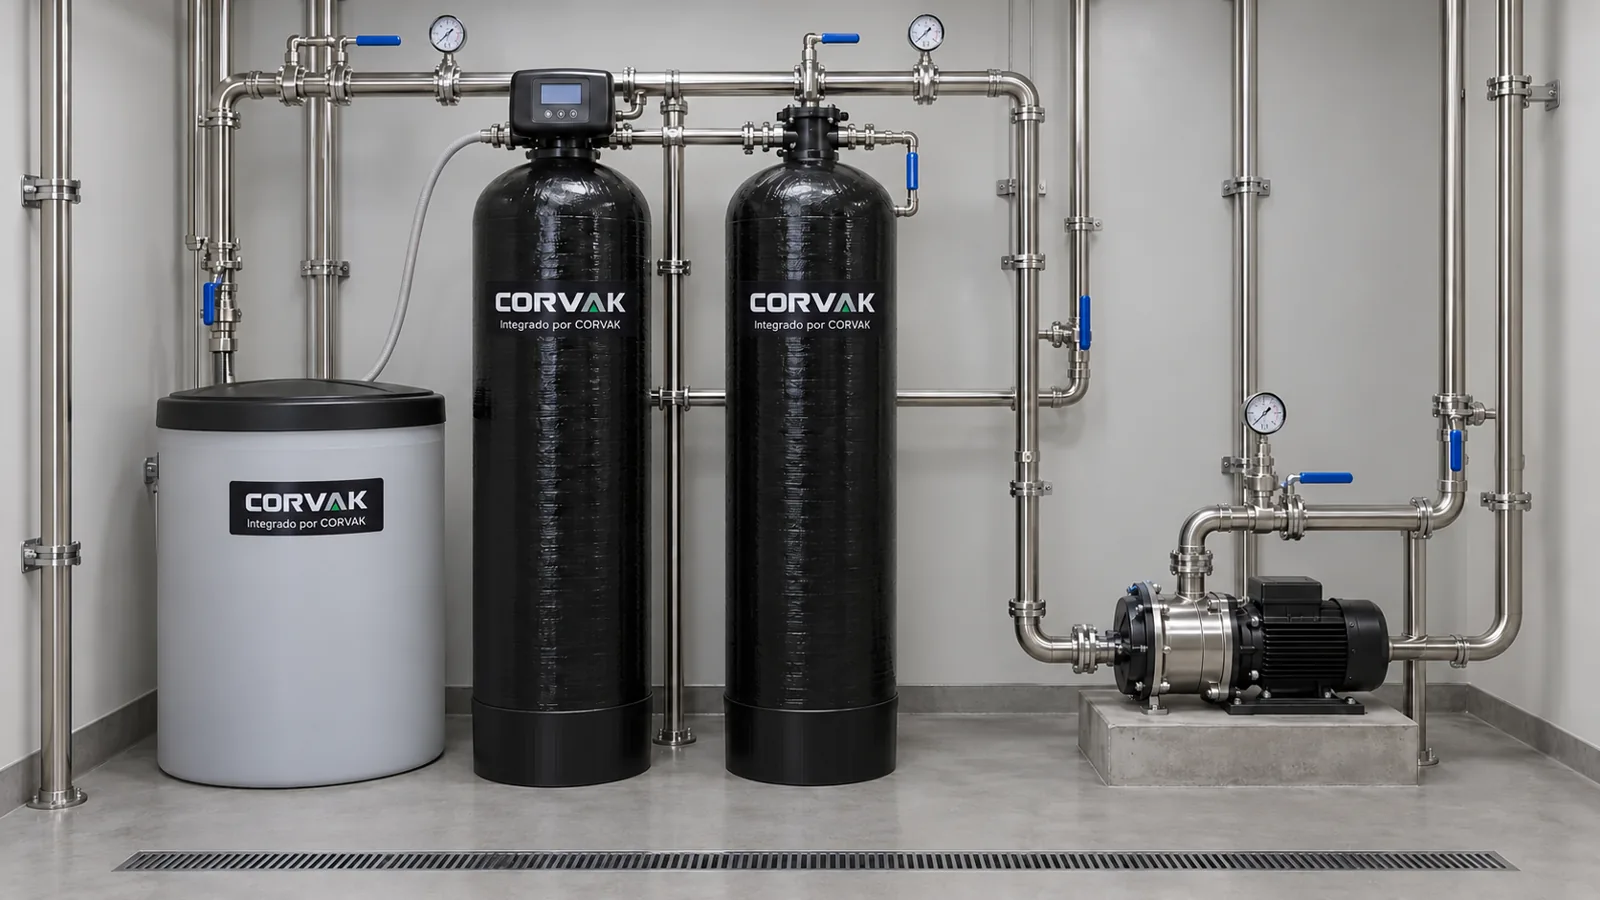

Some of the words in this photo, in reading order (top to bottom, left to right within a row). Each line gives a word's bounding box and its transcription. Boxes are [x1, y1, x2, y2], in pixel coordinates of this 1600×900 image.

[495, 292, 626, 313] CORVAK
[750, 292, 876, 313] CORVAK
[500, 320, 549, 332] Integrado
[553, 321, 572, 332] por
[575, 320, 621, 329] CORVAK
[754, 320, 803, 332] Integrado
[807, 321, 826, 332] por
[828, 320, 871, 330] CORVAK
[245, 490, 368, 512] CORVAK
[247, 519, 297, 531] Integrado
[299, 520, 318, 530] por
[320, 516, 366, 528] CORVAK
